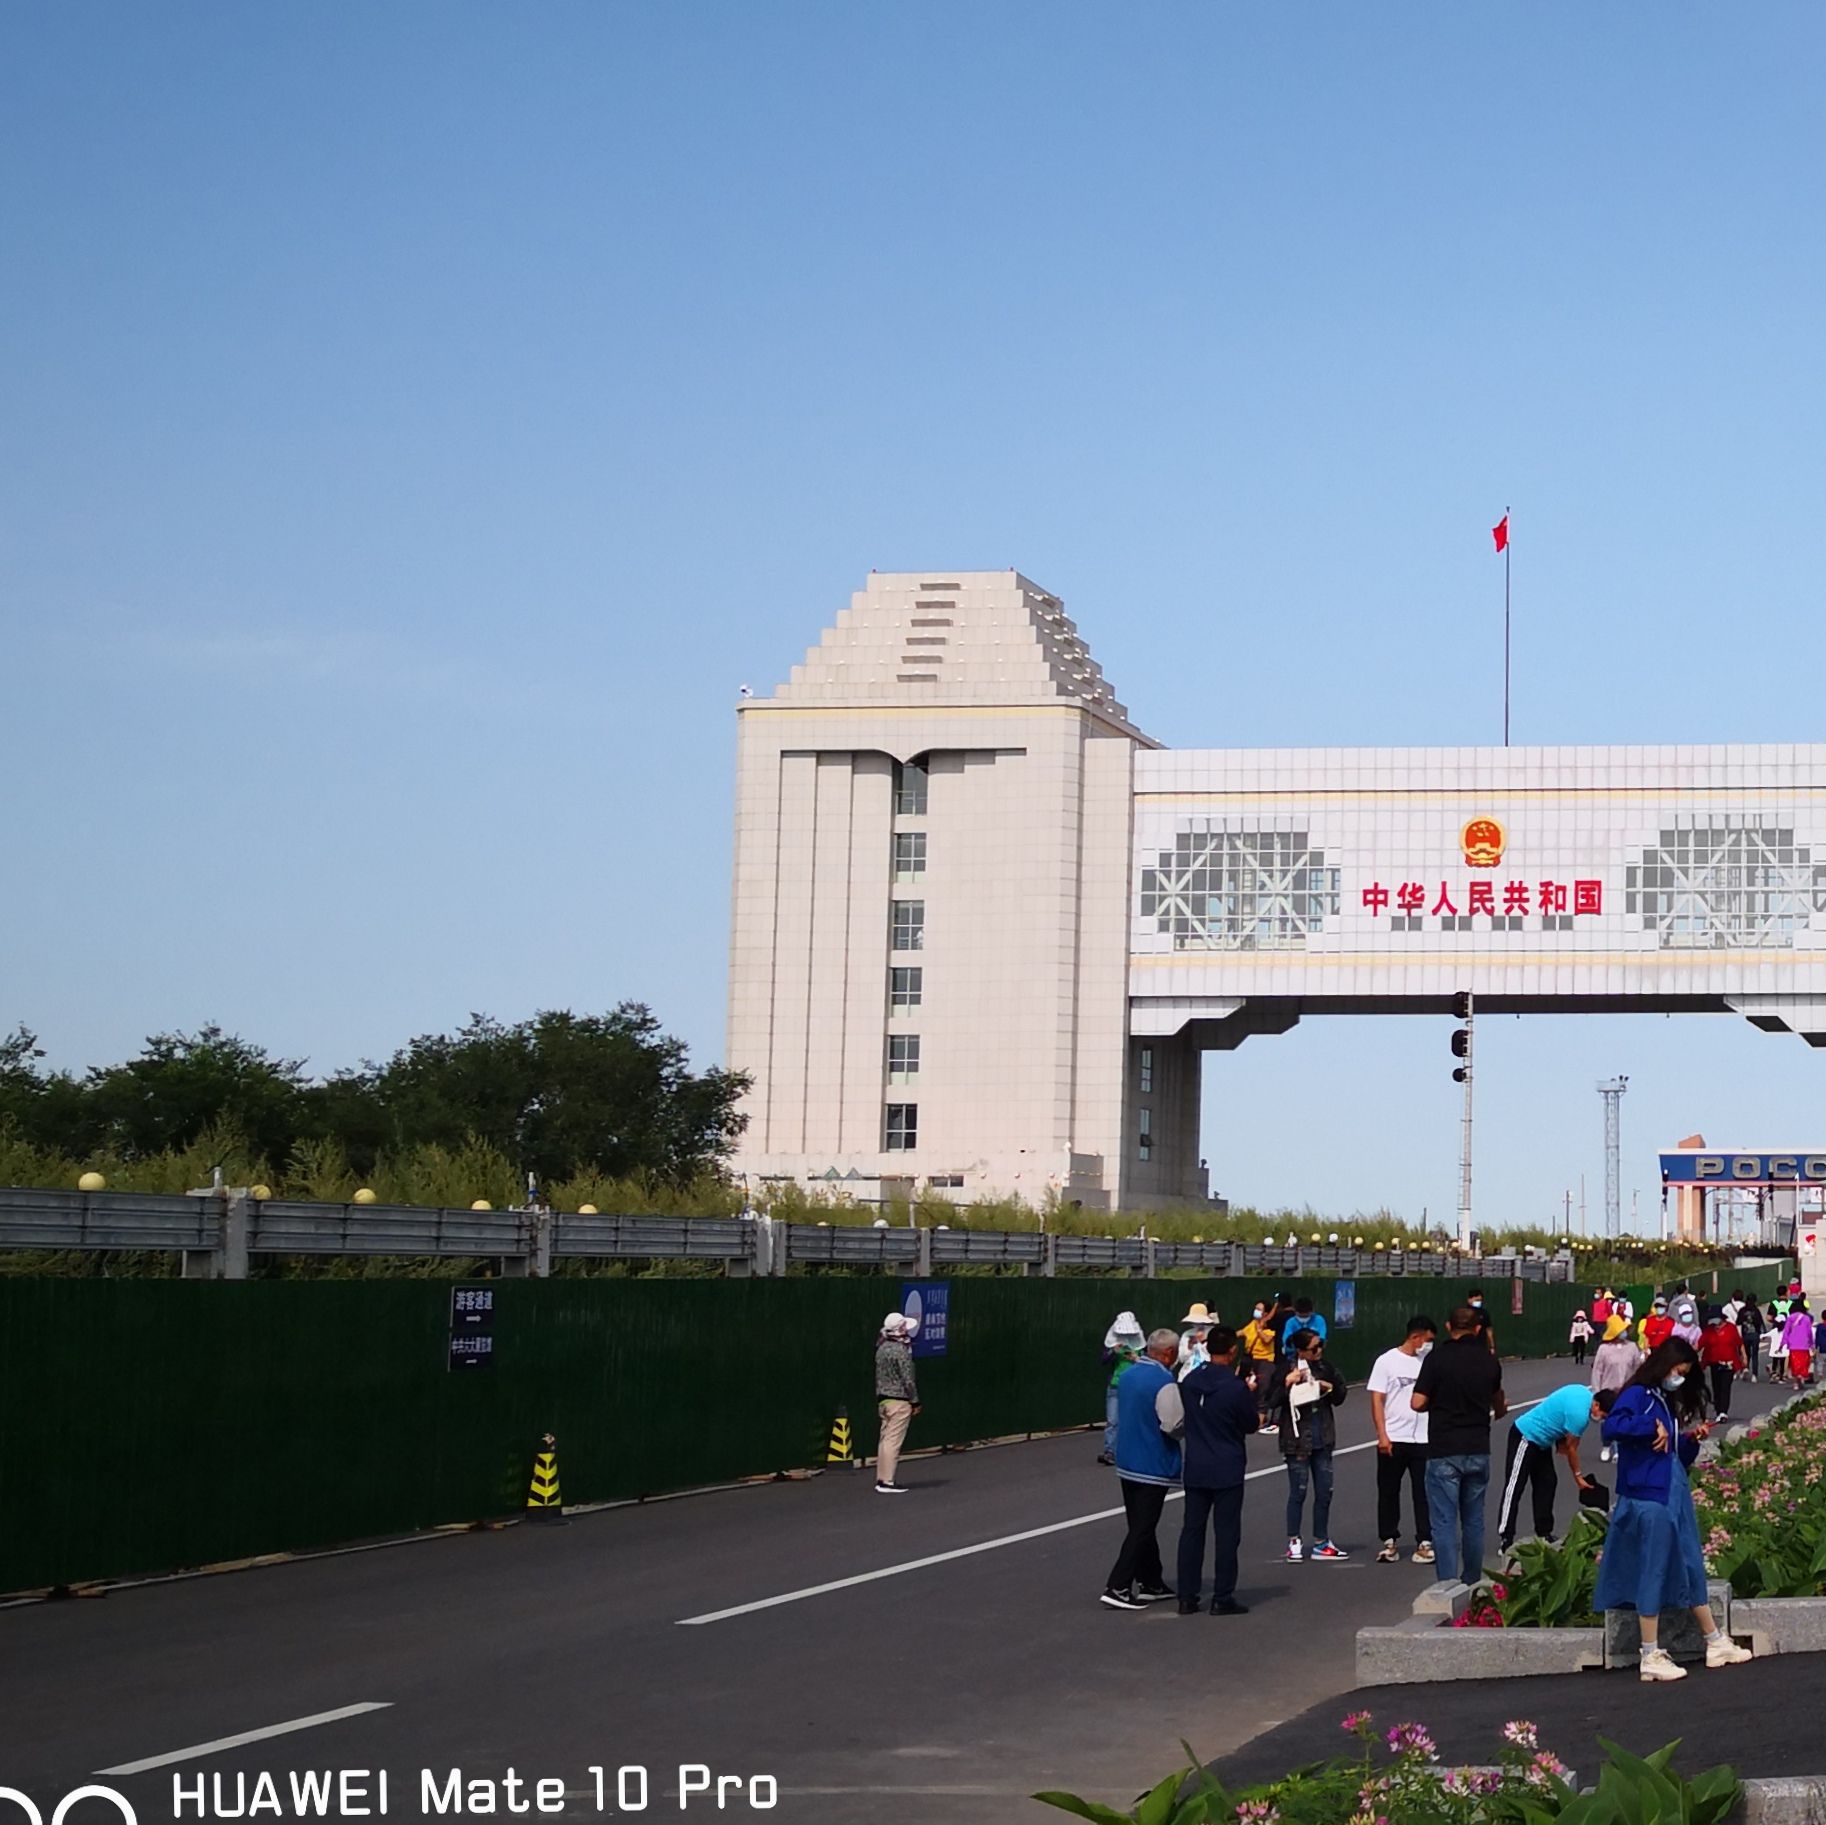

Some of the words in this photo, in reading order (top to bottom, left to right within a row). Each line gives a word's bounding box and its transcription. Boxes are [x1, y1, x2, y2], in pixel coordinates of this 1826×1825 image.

[1362, 880, 1602, 918] 中华人民共和国
